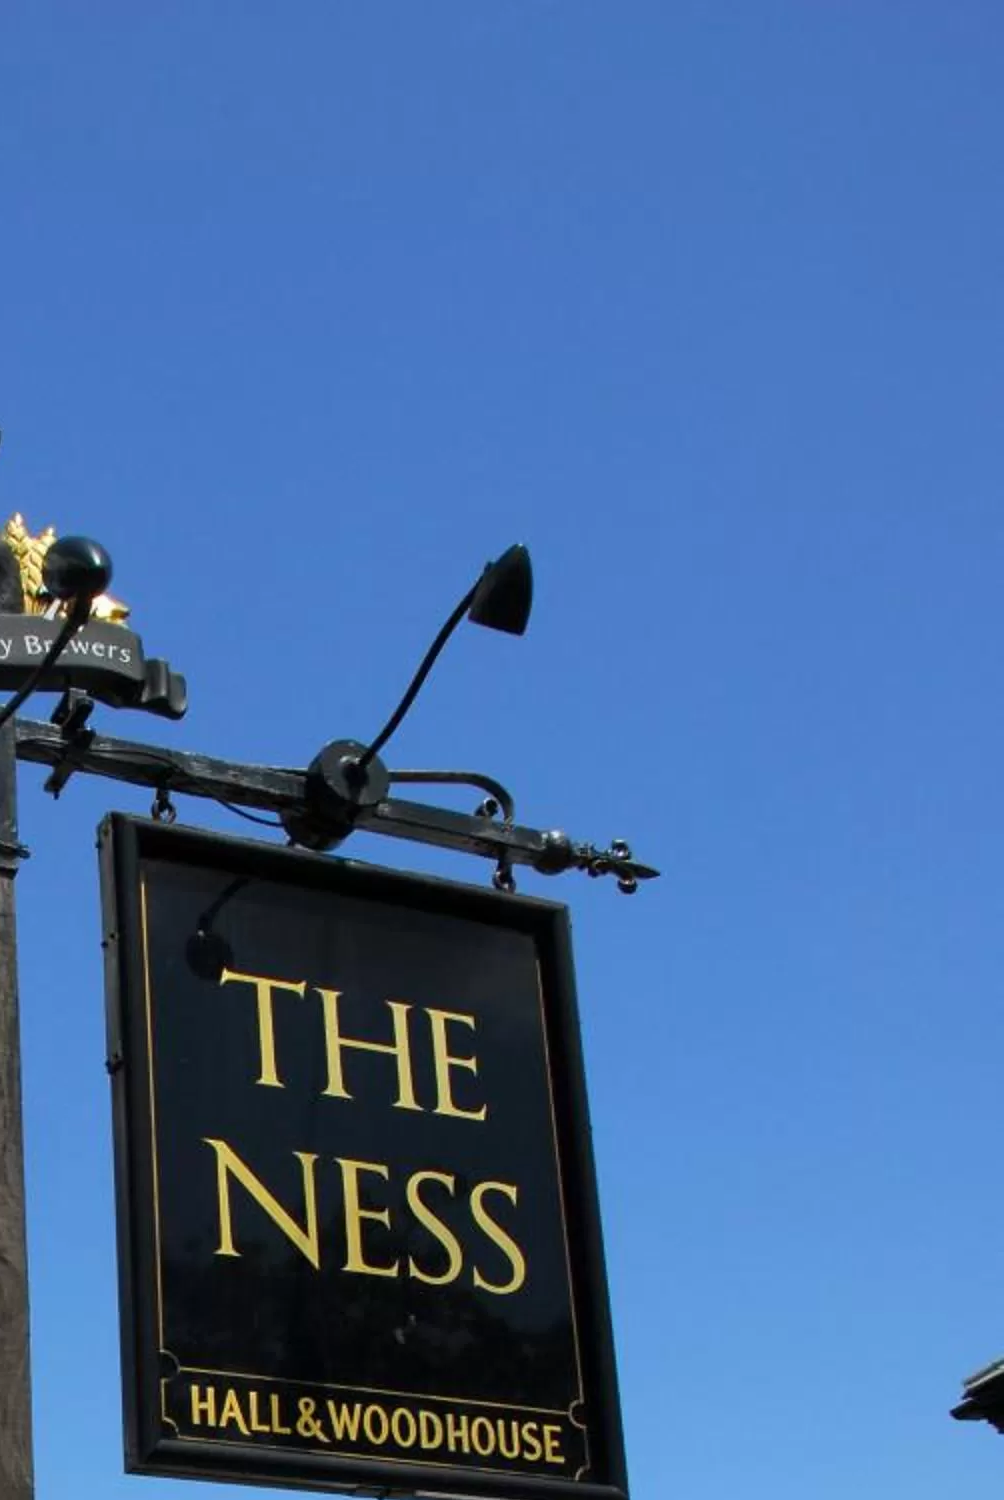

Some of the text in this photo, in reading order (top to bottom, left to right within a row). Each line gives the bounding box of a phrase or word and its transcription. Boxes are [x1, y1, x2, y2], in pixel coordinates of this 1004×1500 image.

[23, 634, 132, 663] Brwers
[219, 967, 488, 1121] THE
[200, 1137, 526, 1295] NESS
